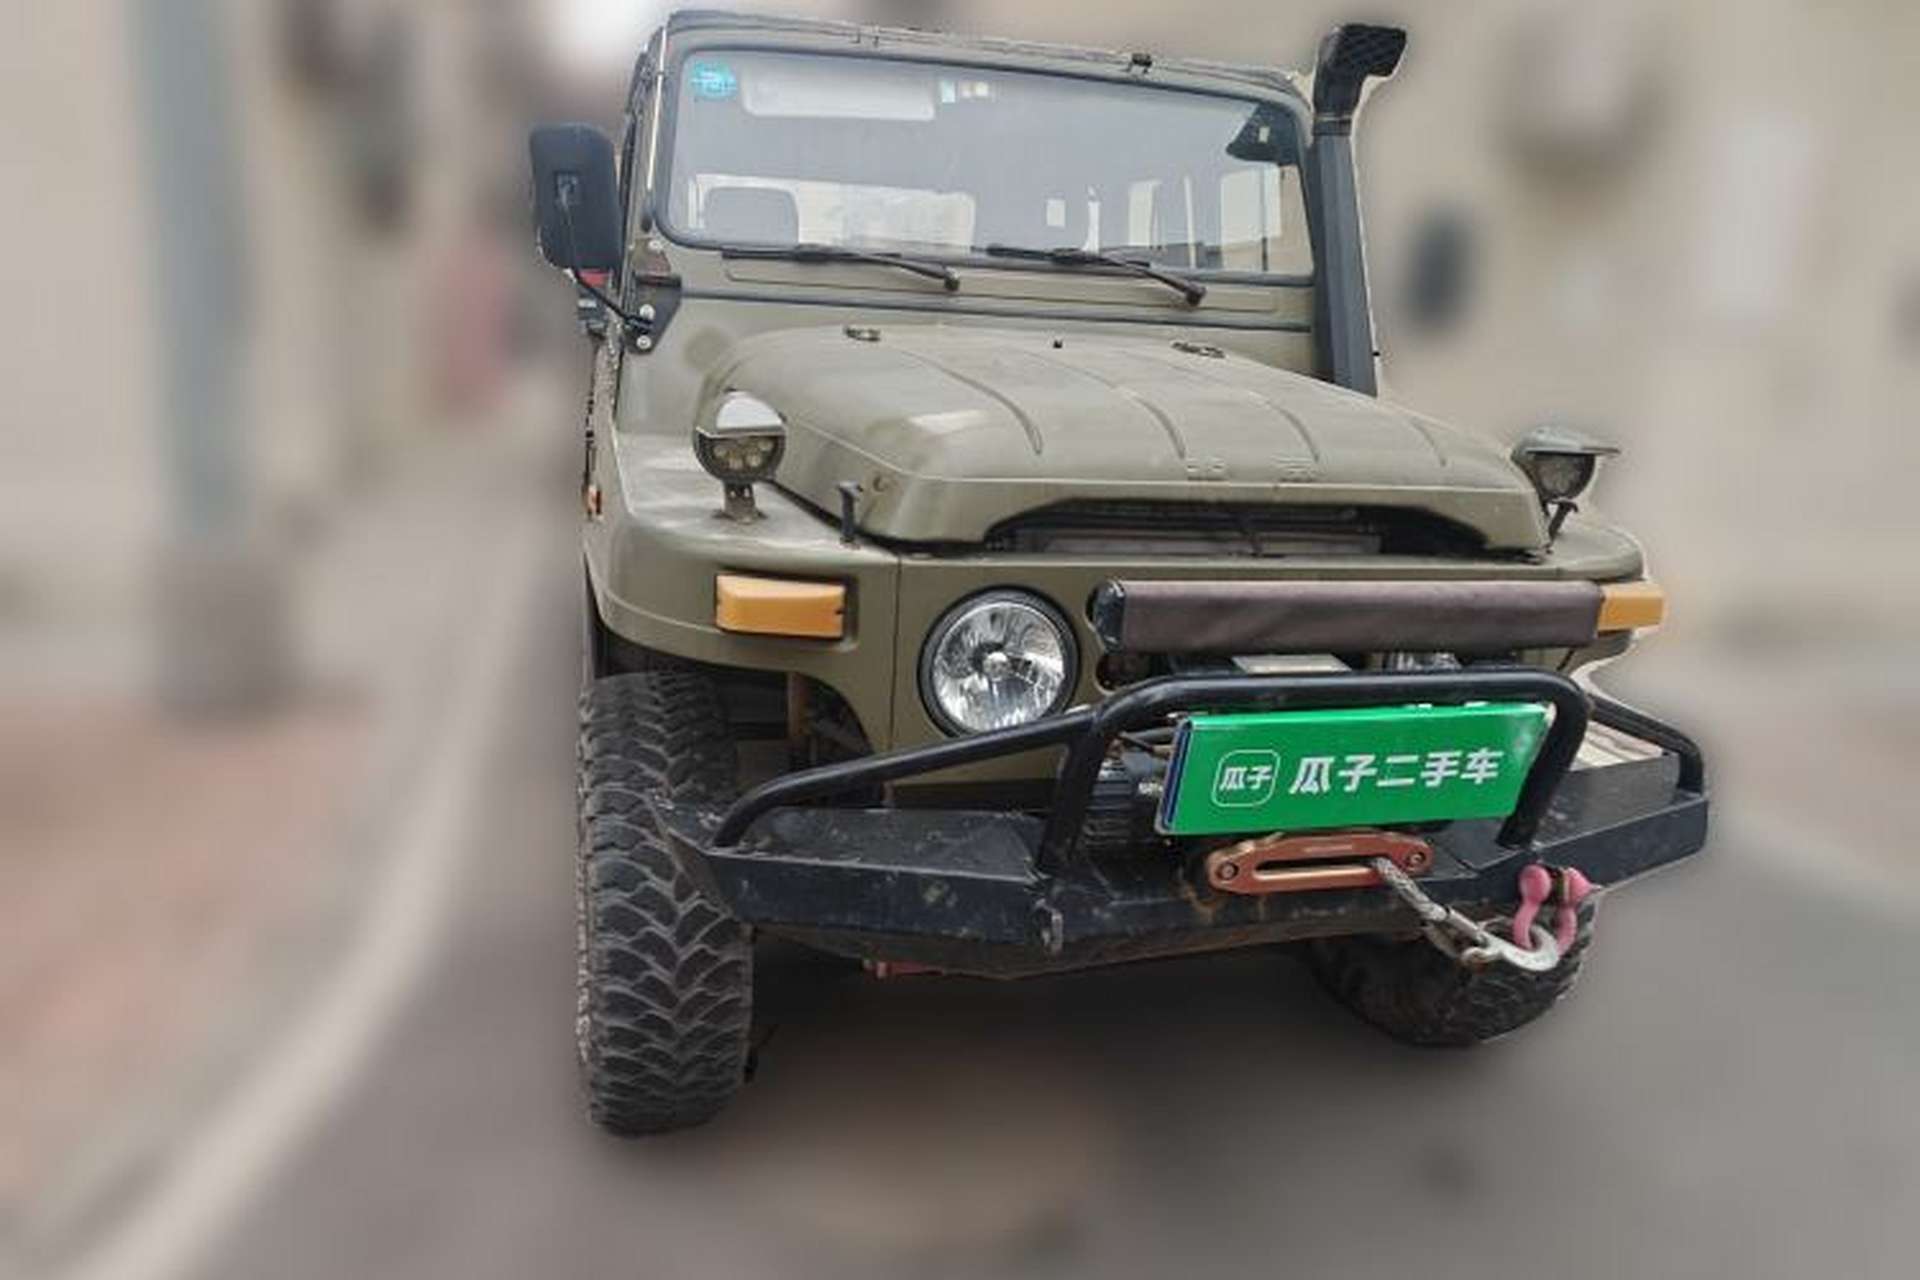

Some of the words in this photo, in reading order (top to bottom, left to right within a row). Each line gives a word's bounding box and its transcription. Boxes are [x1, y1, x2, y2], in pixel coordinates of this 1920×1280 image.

[1219, 766, 1273, 790] 瓜子
[1289, 748, 1504, 794] 瓜子二手车
